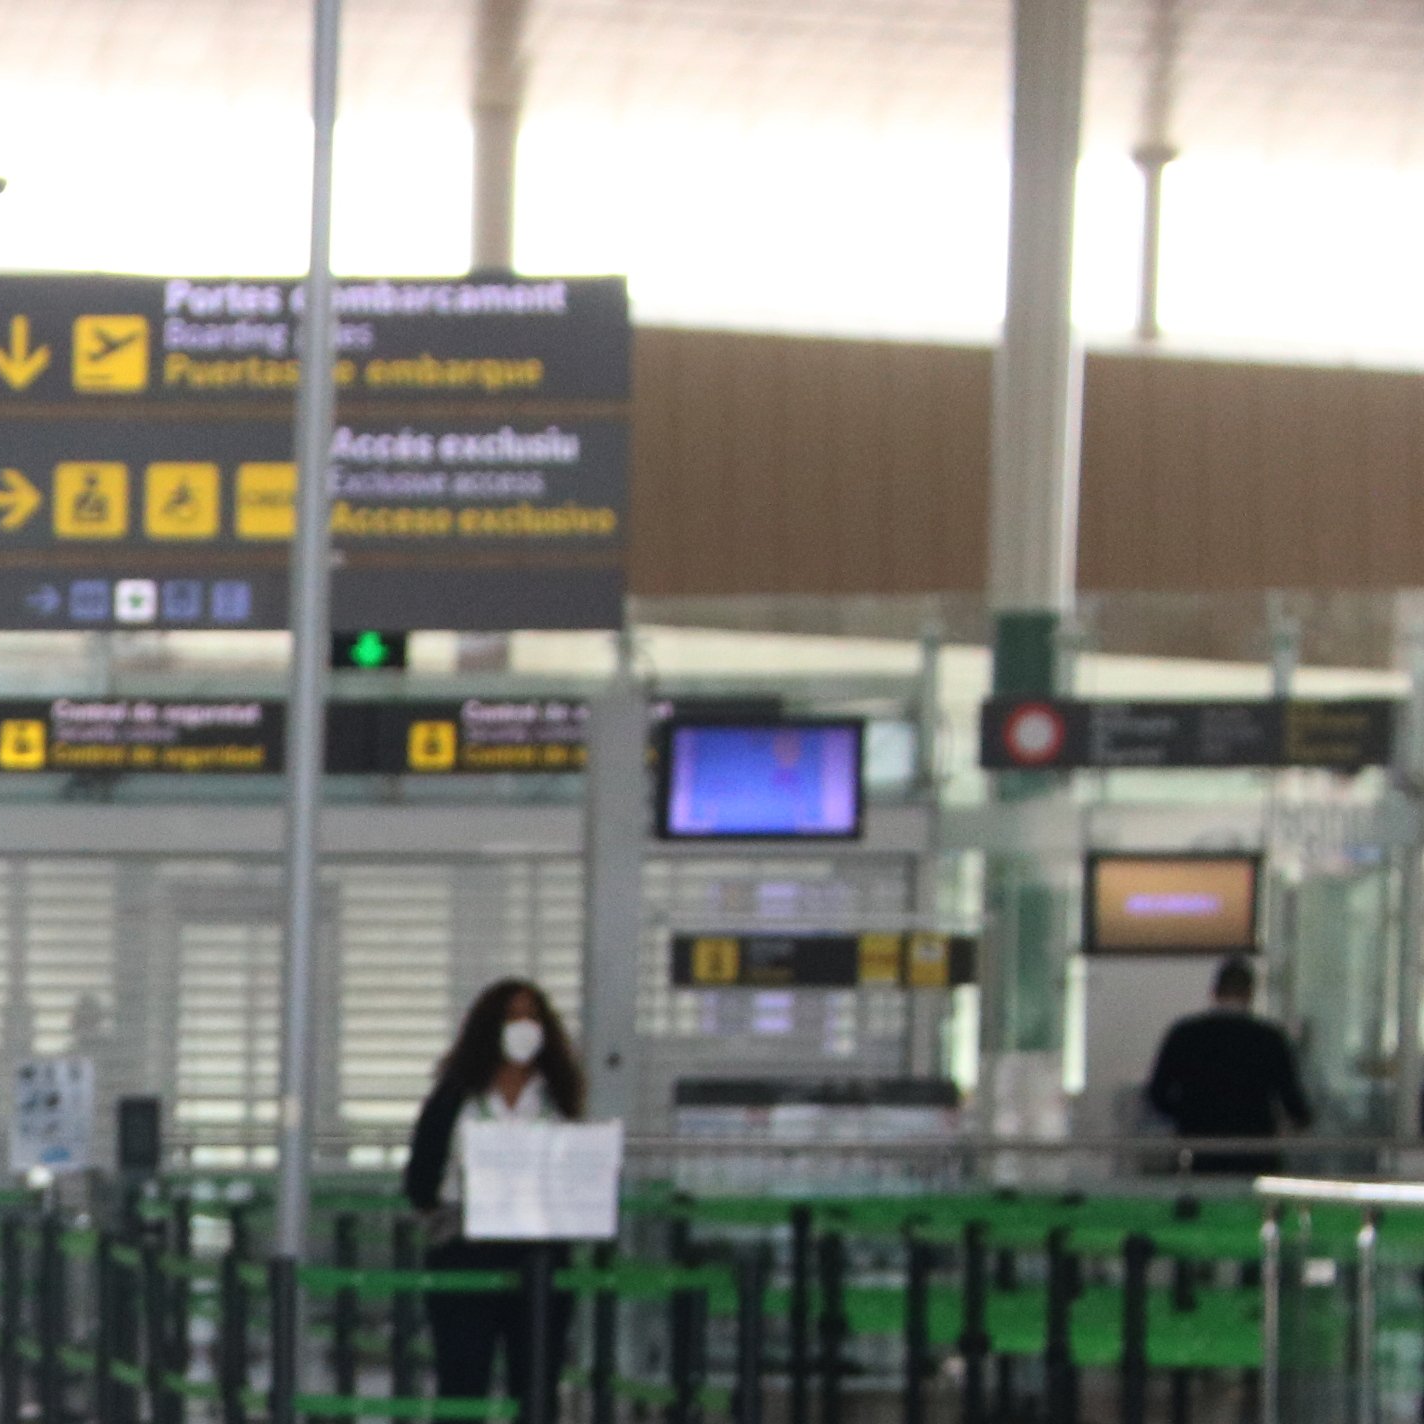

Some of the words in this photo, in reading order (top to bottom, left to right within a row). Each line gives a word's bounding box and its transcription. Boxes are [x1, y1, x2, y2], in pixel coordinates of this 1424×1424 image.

[163, 281, 282, 315] Portes
[164, 318, 289, 354] Boarding
[164, 353, 299, 387] Puertas
[366, 354, 546, 389] embarque
[437, 425, 581, 465] exclusiu
[330, 502, 453, 536] Acceso
[457, 501, 617, 537] exclusivo
[52, 698, 128, 723] Control
[133, 701, 158, 723] de
[461, 699, 538, 722] Control
[53, 742, 127, 767] Control
[132, 744, 157, 767] de
